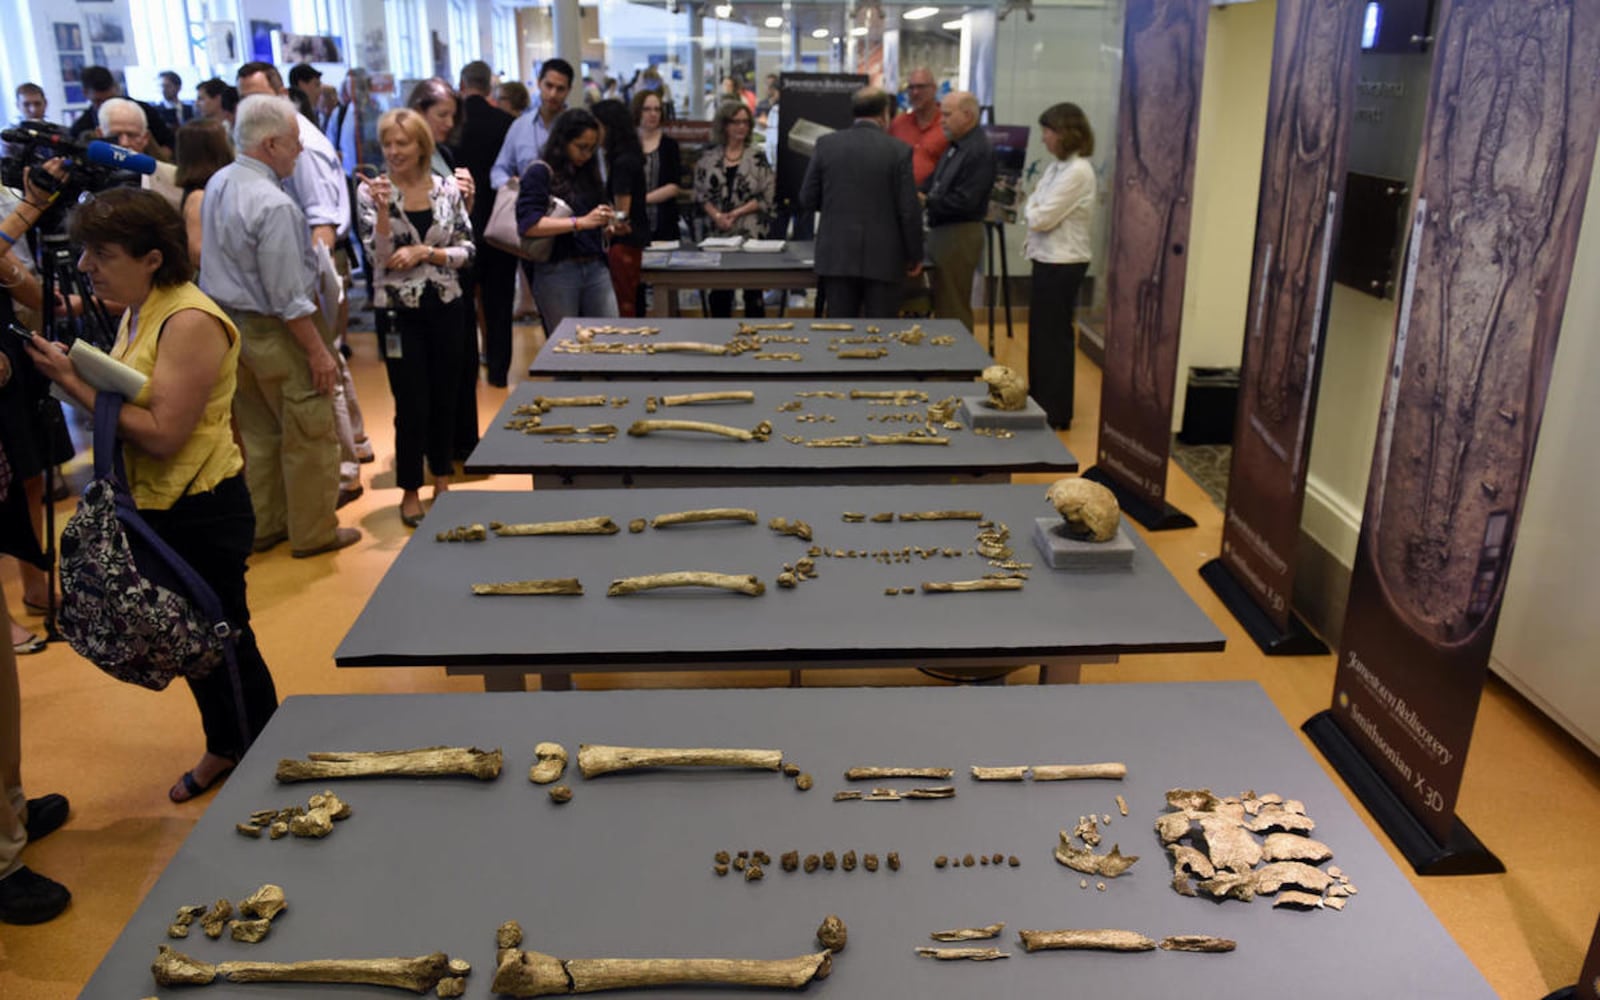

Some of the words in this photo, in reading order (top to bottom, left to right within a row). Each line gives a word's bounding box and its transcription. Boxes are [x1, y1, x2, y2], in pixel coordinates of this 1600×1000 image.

[113, 151, 126, 161] TV
[1350, 703, 1412, 781] Smithsonian
[1414, 773, 1425, 794] X
[1423, 786, 1444, 812] 3D
